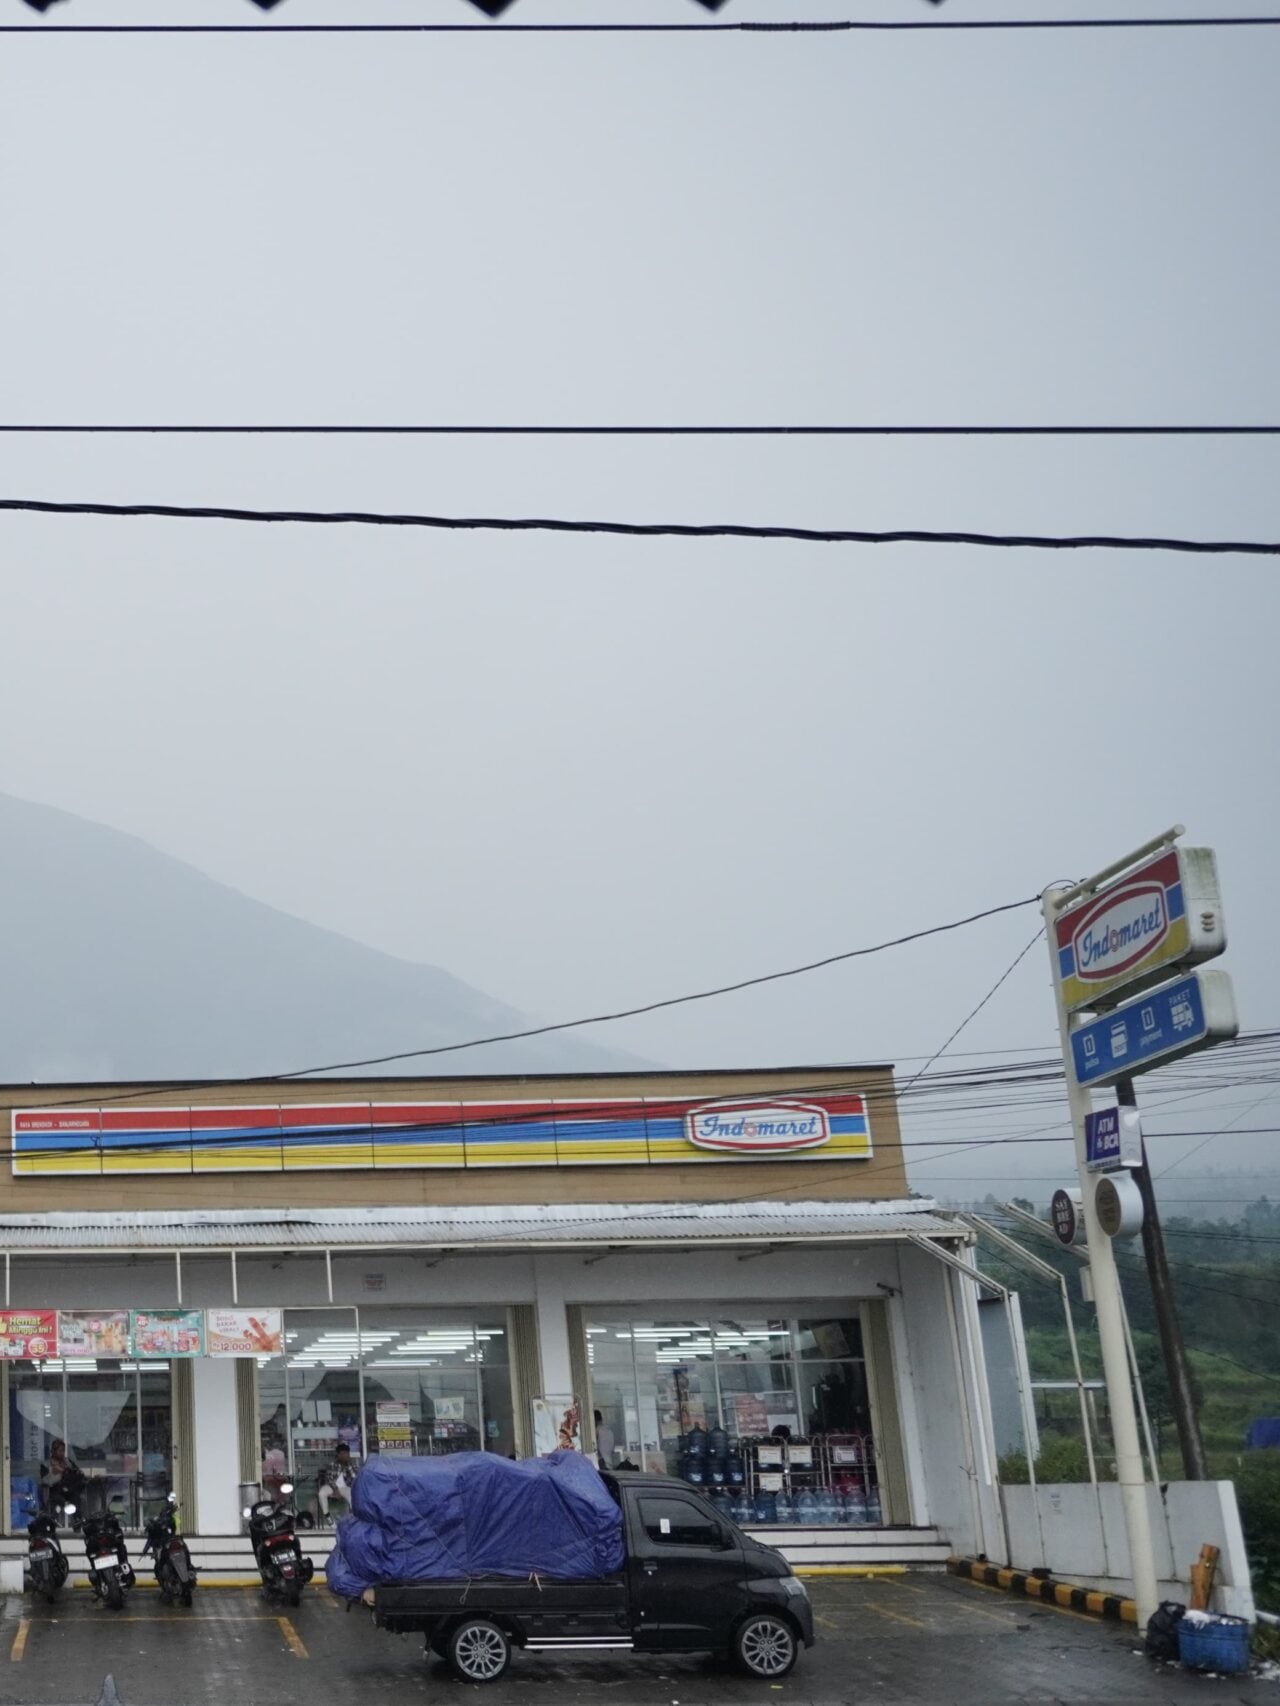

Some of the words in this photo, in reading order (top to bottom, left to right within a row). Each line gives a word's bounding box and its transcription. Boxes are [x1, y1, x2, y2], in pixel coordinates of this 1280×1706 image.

[1081, 897, 1161, 967] Indomaret
[700, 1115, 817, 1137] Indomaret
[1097, 1116, 1115, 1135] ATM
[1104, 1133, 1120, 1151] BCA
[9, 1316, 41, 1326] Hemat
[220, 1342, 252, 1351] 12.000
